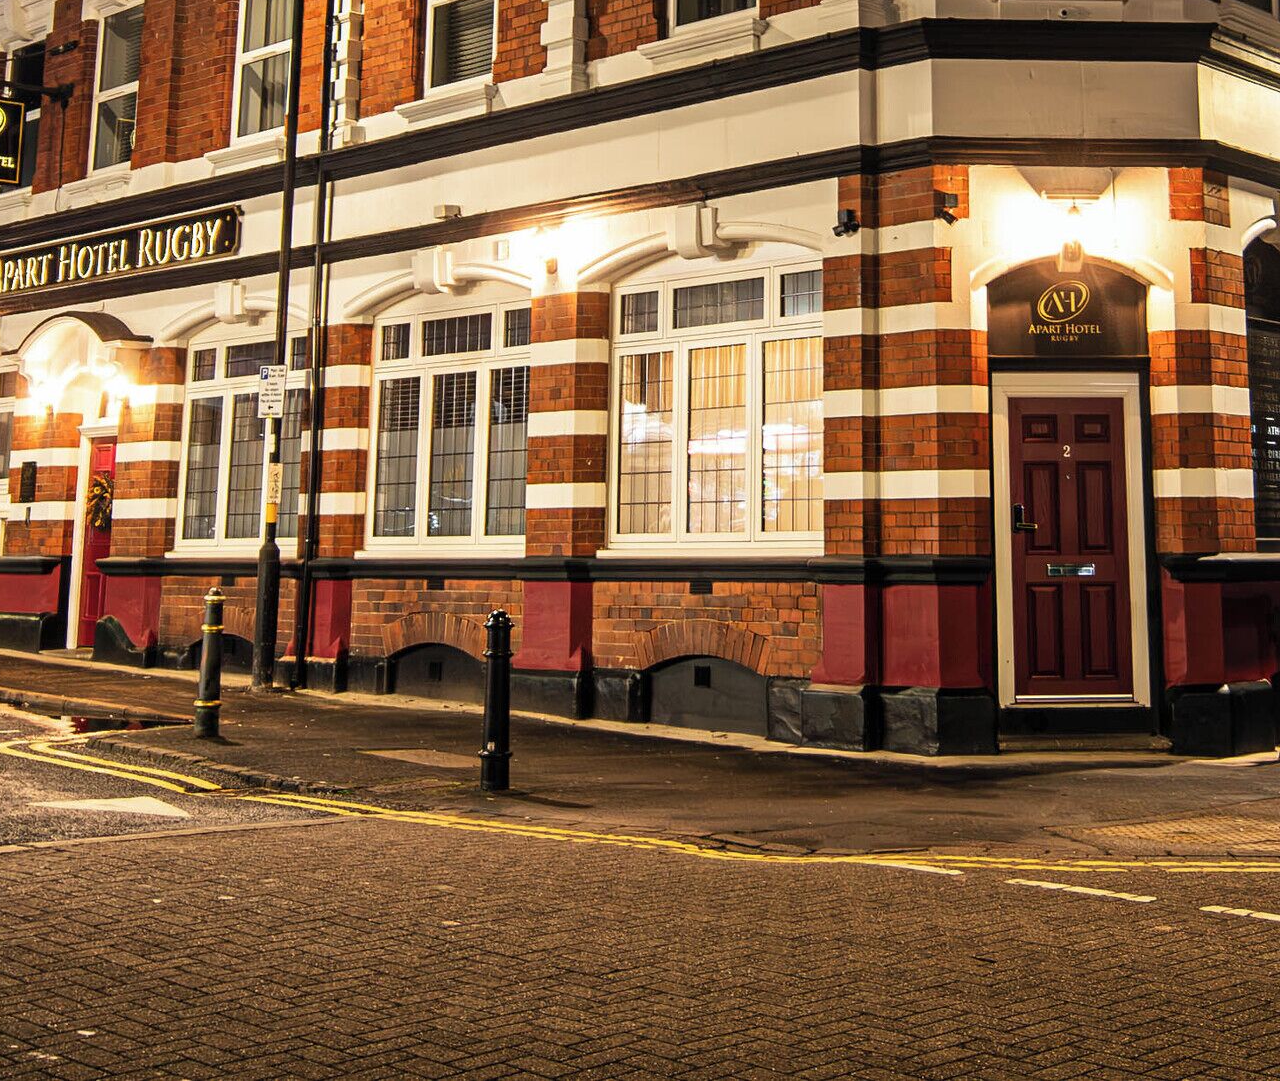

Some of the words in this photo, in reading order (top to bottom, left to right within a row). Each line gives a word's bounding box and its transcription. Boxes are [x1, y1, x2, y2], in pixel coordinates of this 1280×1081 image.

[56, 237, 131, 284] HOTEL
[135, 218, 223, 269] RUGBY
[1028, 323, 1061, 334] APART
[1065, 323, 1102, 334] HOTEL
[1063, 444, 1071, 458] 2
